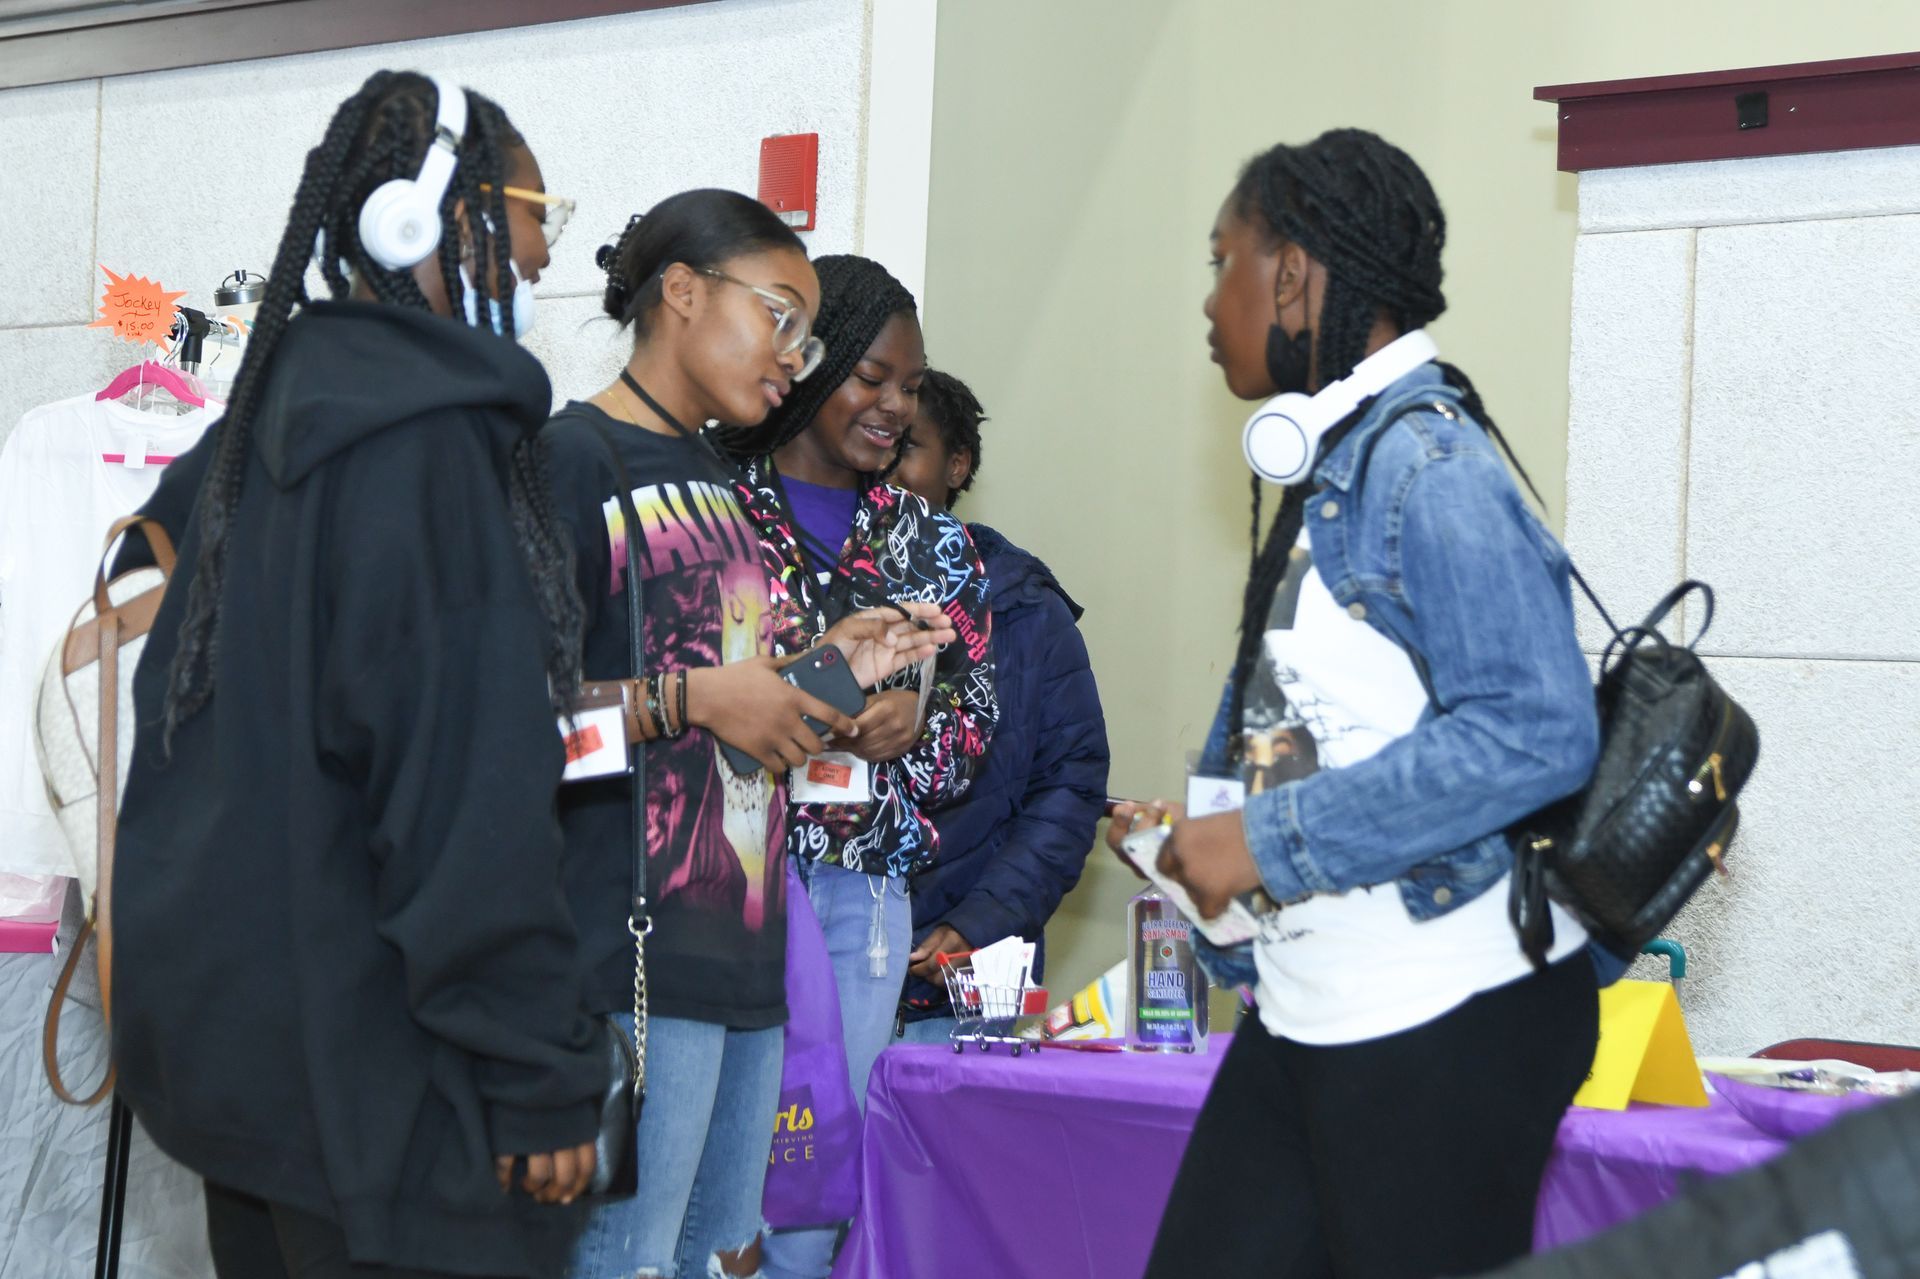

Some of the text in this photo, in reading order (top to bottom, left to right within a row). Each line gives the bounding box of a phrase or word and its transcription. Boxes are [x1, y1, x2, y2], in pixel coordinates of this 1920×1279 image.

[113, 292, 161, 317] Jockey
[1147, 969, 1185, 988] HAND
[773, 1103, 814, 1134] rls
[768, 1144, 815, 1165] NCE
